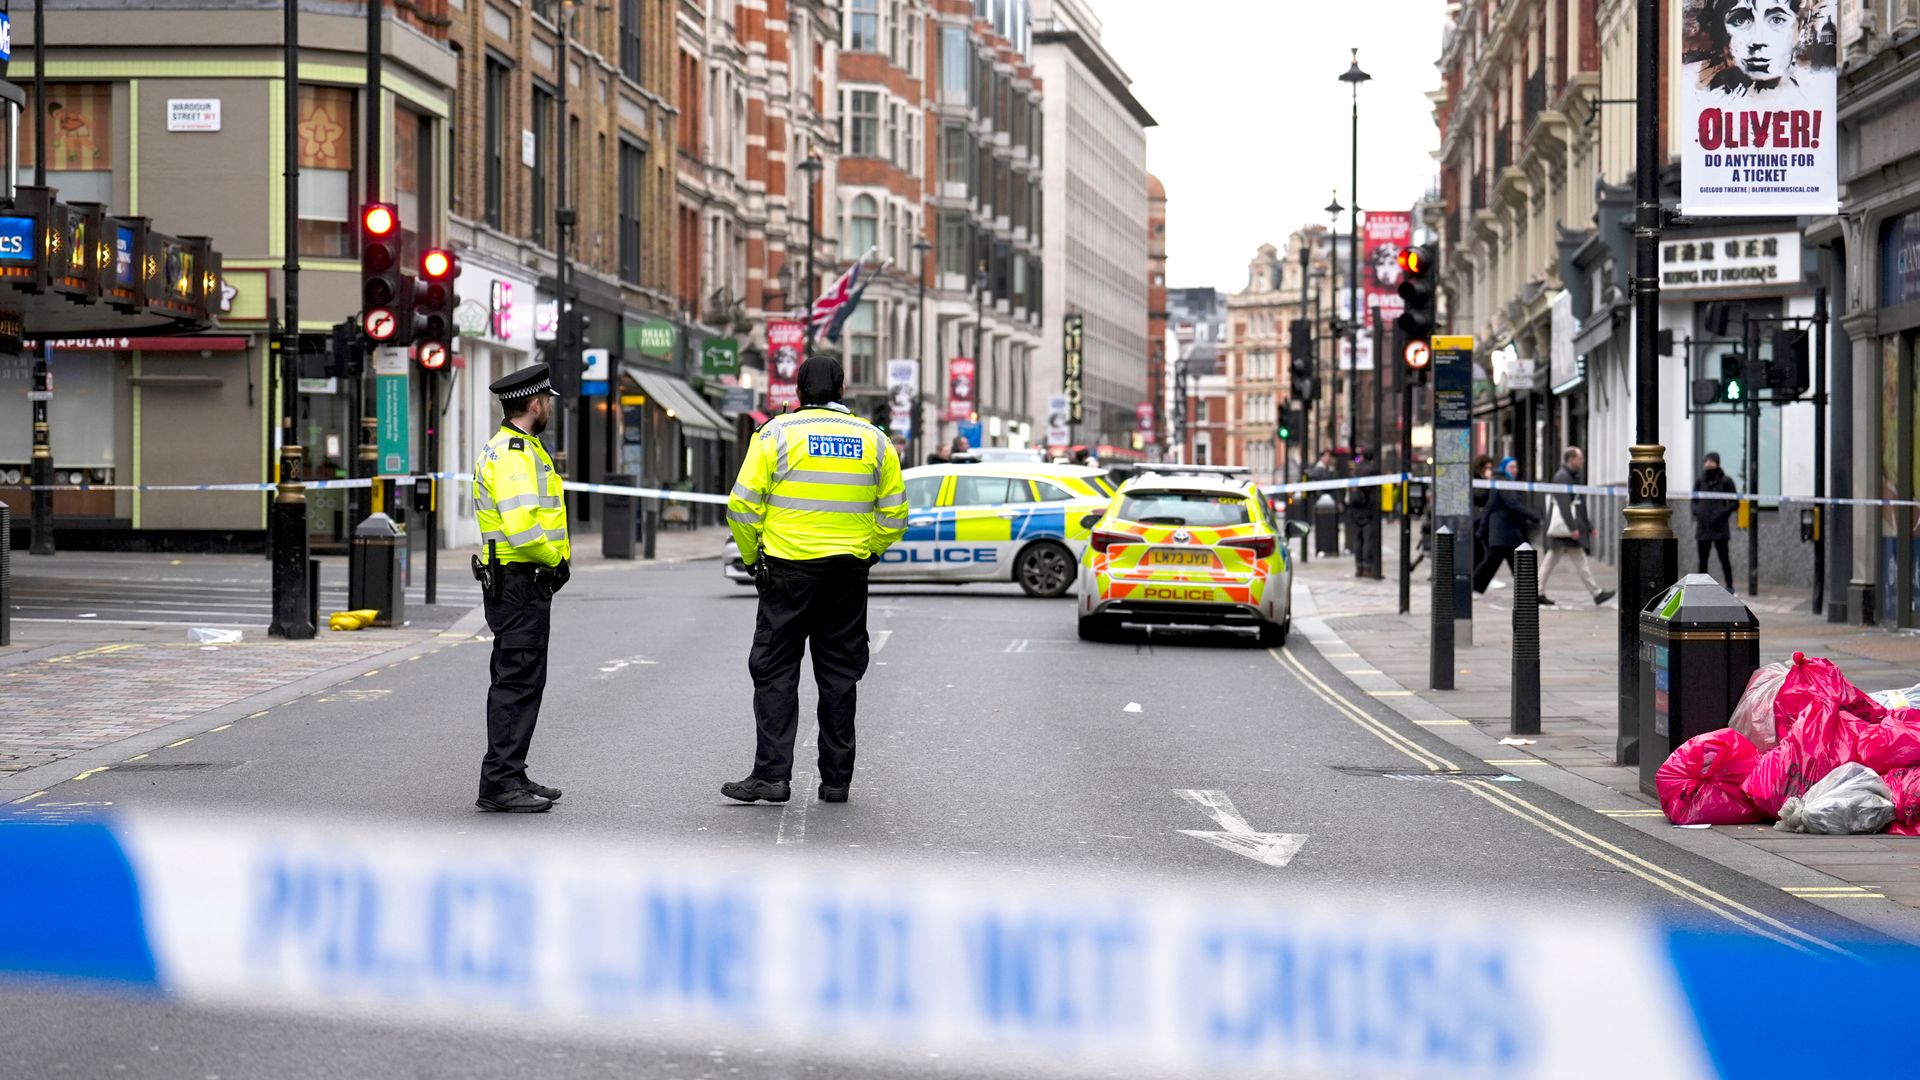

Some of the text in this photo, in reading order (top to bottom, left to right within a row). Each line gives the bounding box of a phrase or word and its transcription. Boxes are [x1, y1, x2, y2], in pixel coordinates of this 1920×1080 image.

[172, 103, 211, 111] WARDOUR
[172, 112, 216, 121] STREET W1
[1698, 107, 1822, 151] OLIVER!
[1704, 154, 1815, 167] DO ANYTHING FOR
[1732, 169, 1787, 182] A TICKET
[1663, 265, 1777, 284] KUNG FU NOODLE
[642, 328, 671, 337] BELLA
[641, 337, 671, 347] ITALIA
[810, 435, 861, 444] METROPOLITAN
[810, 442, 862, 457] POLICE
[879, 548, 998, 563] OLICE
[1154, 552, 1183, 564] LM73
[1144, 588, 1214, 601] POLICE
[248, 858, 540, 985] POLICE
